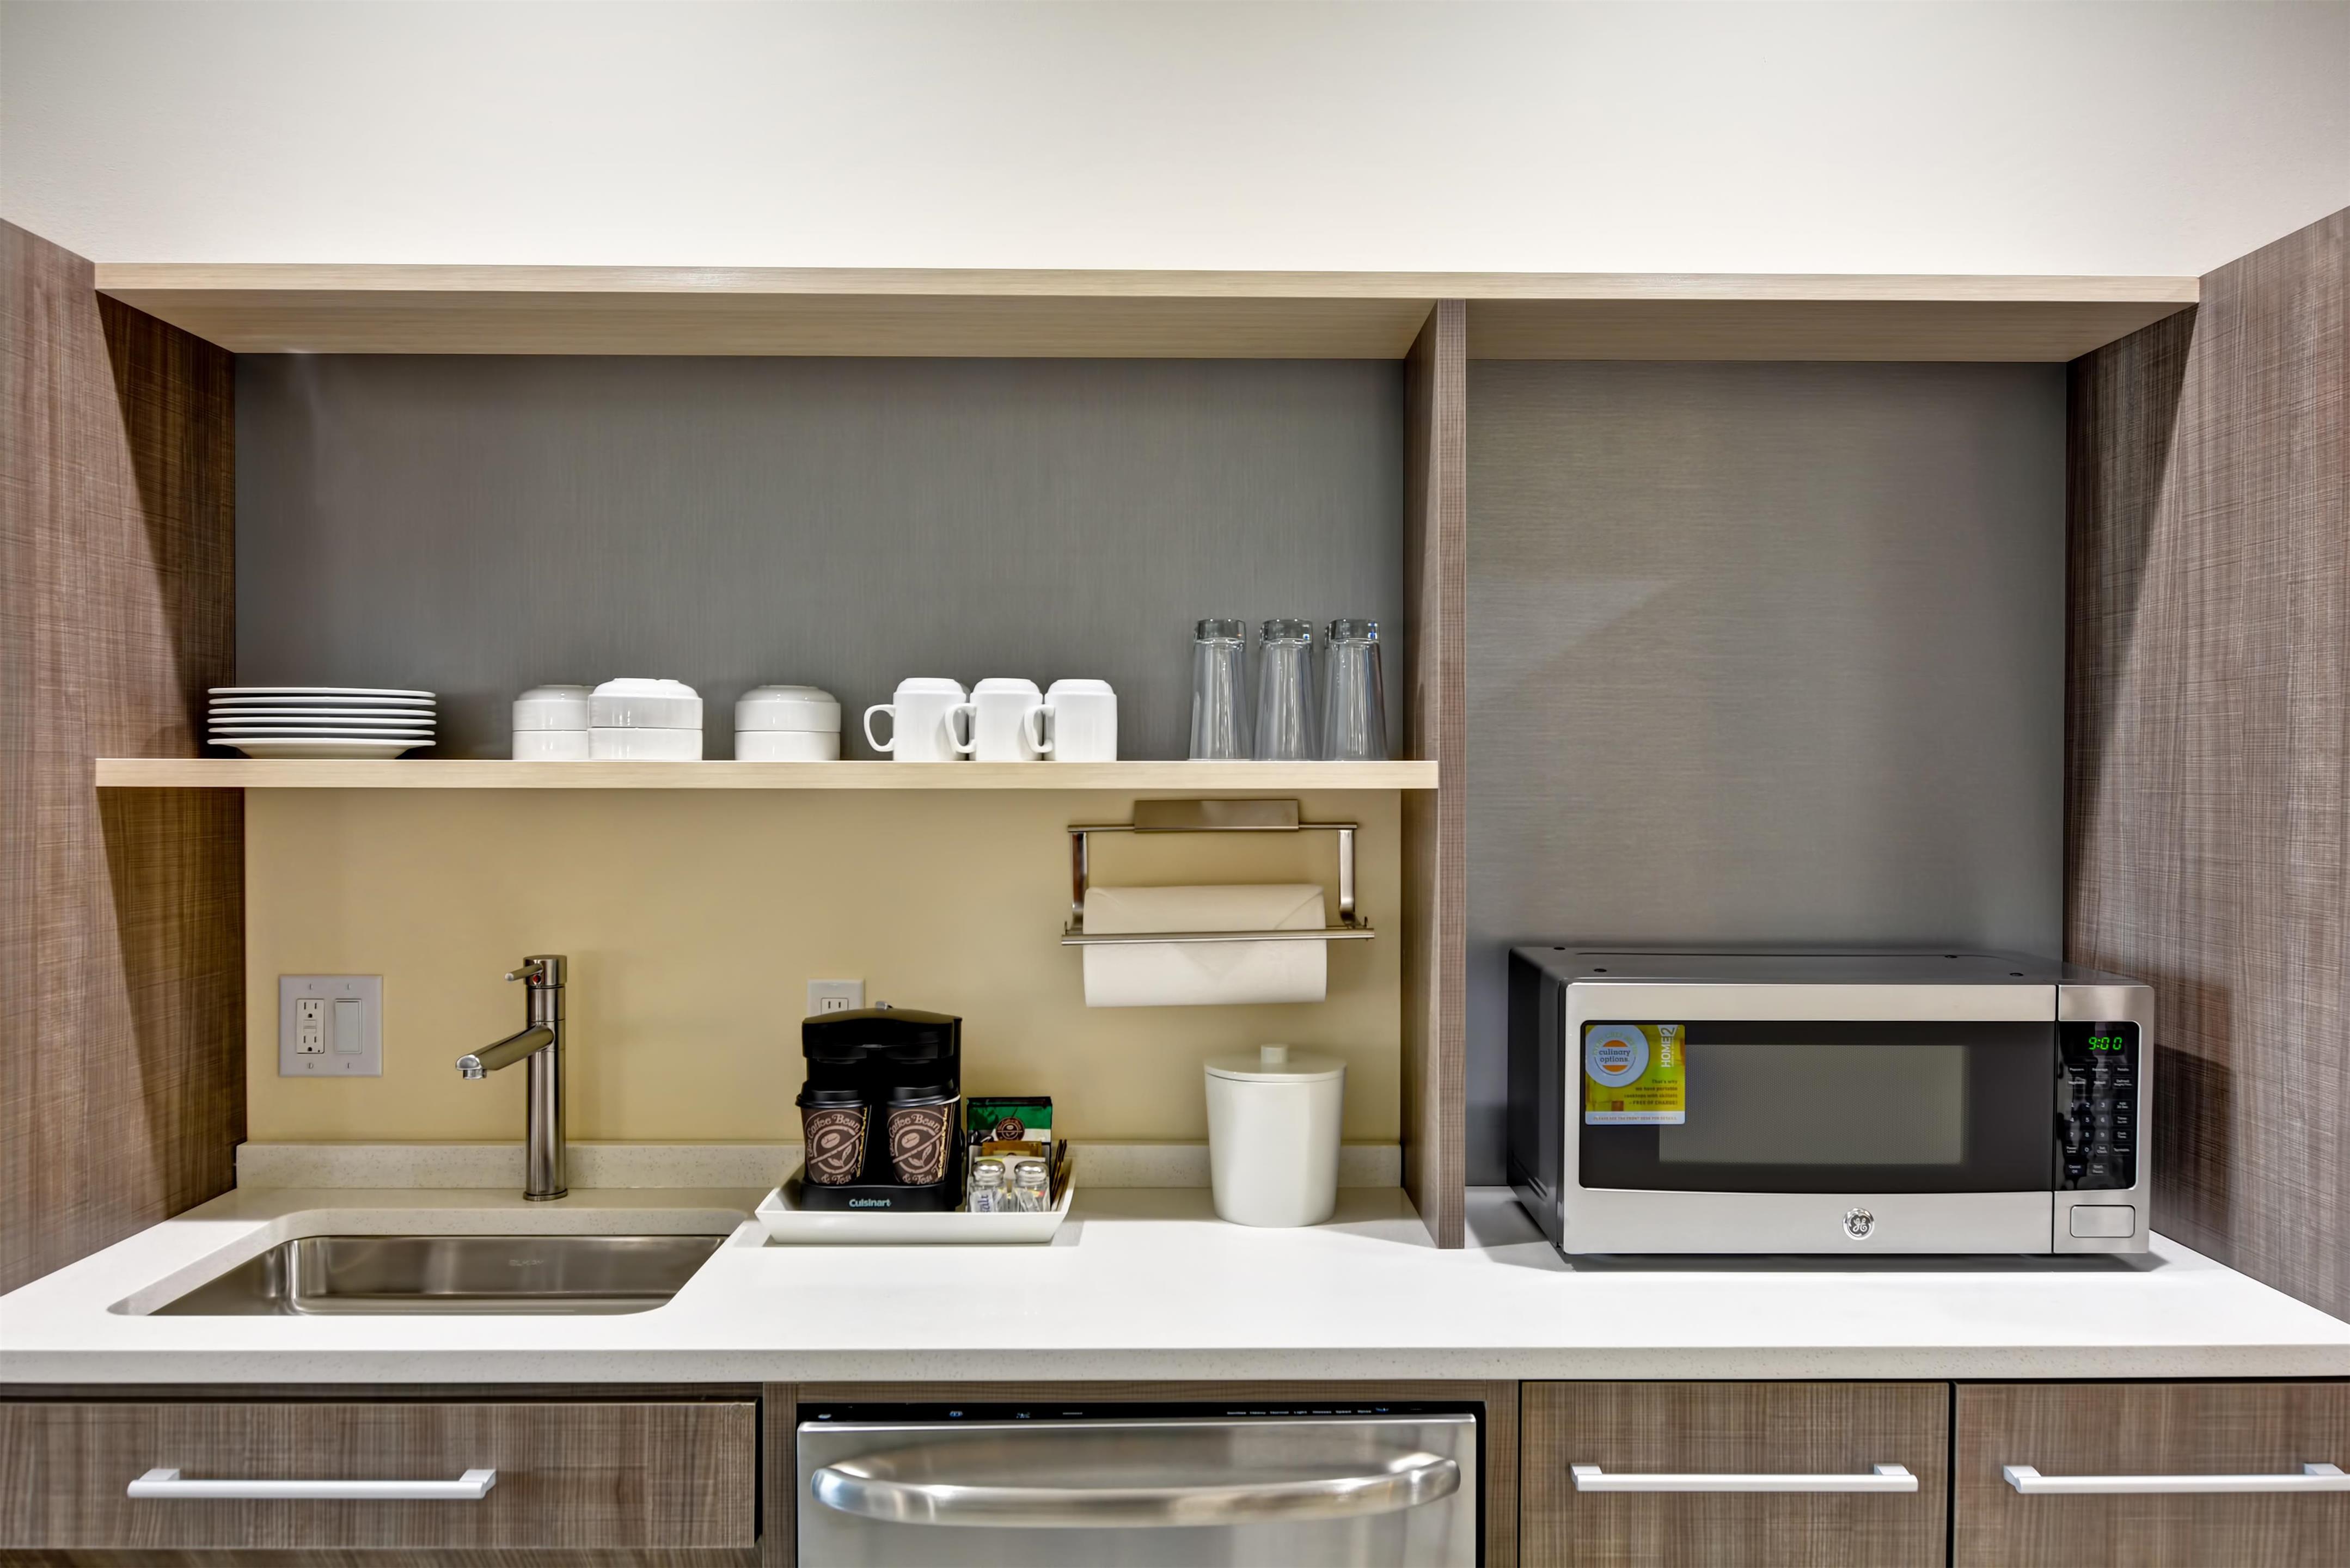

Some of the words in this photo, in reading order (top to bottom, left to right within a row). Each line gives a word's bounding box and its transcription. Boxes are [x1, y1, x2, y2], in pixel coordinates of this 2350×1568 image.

[2089, 1037, 2122, 1050] 9:00
[807, 1117, 831, 1139] Coffee
[831, 1114, 860, 1132] Bean
[889, 1117, 911, 1138] Coffee
[911, 1114, 940, 1132] Bean
[821, 1174, 830, 1184] &
[902, 1173, 911, 1184] &
[849, 1198, 891, 1207] Cuisinart
